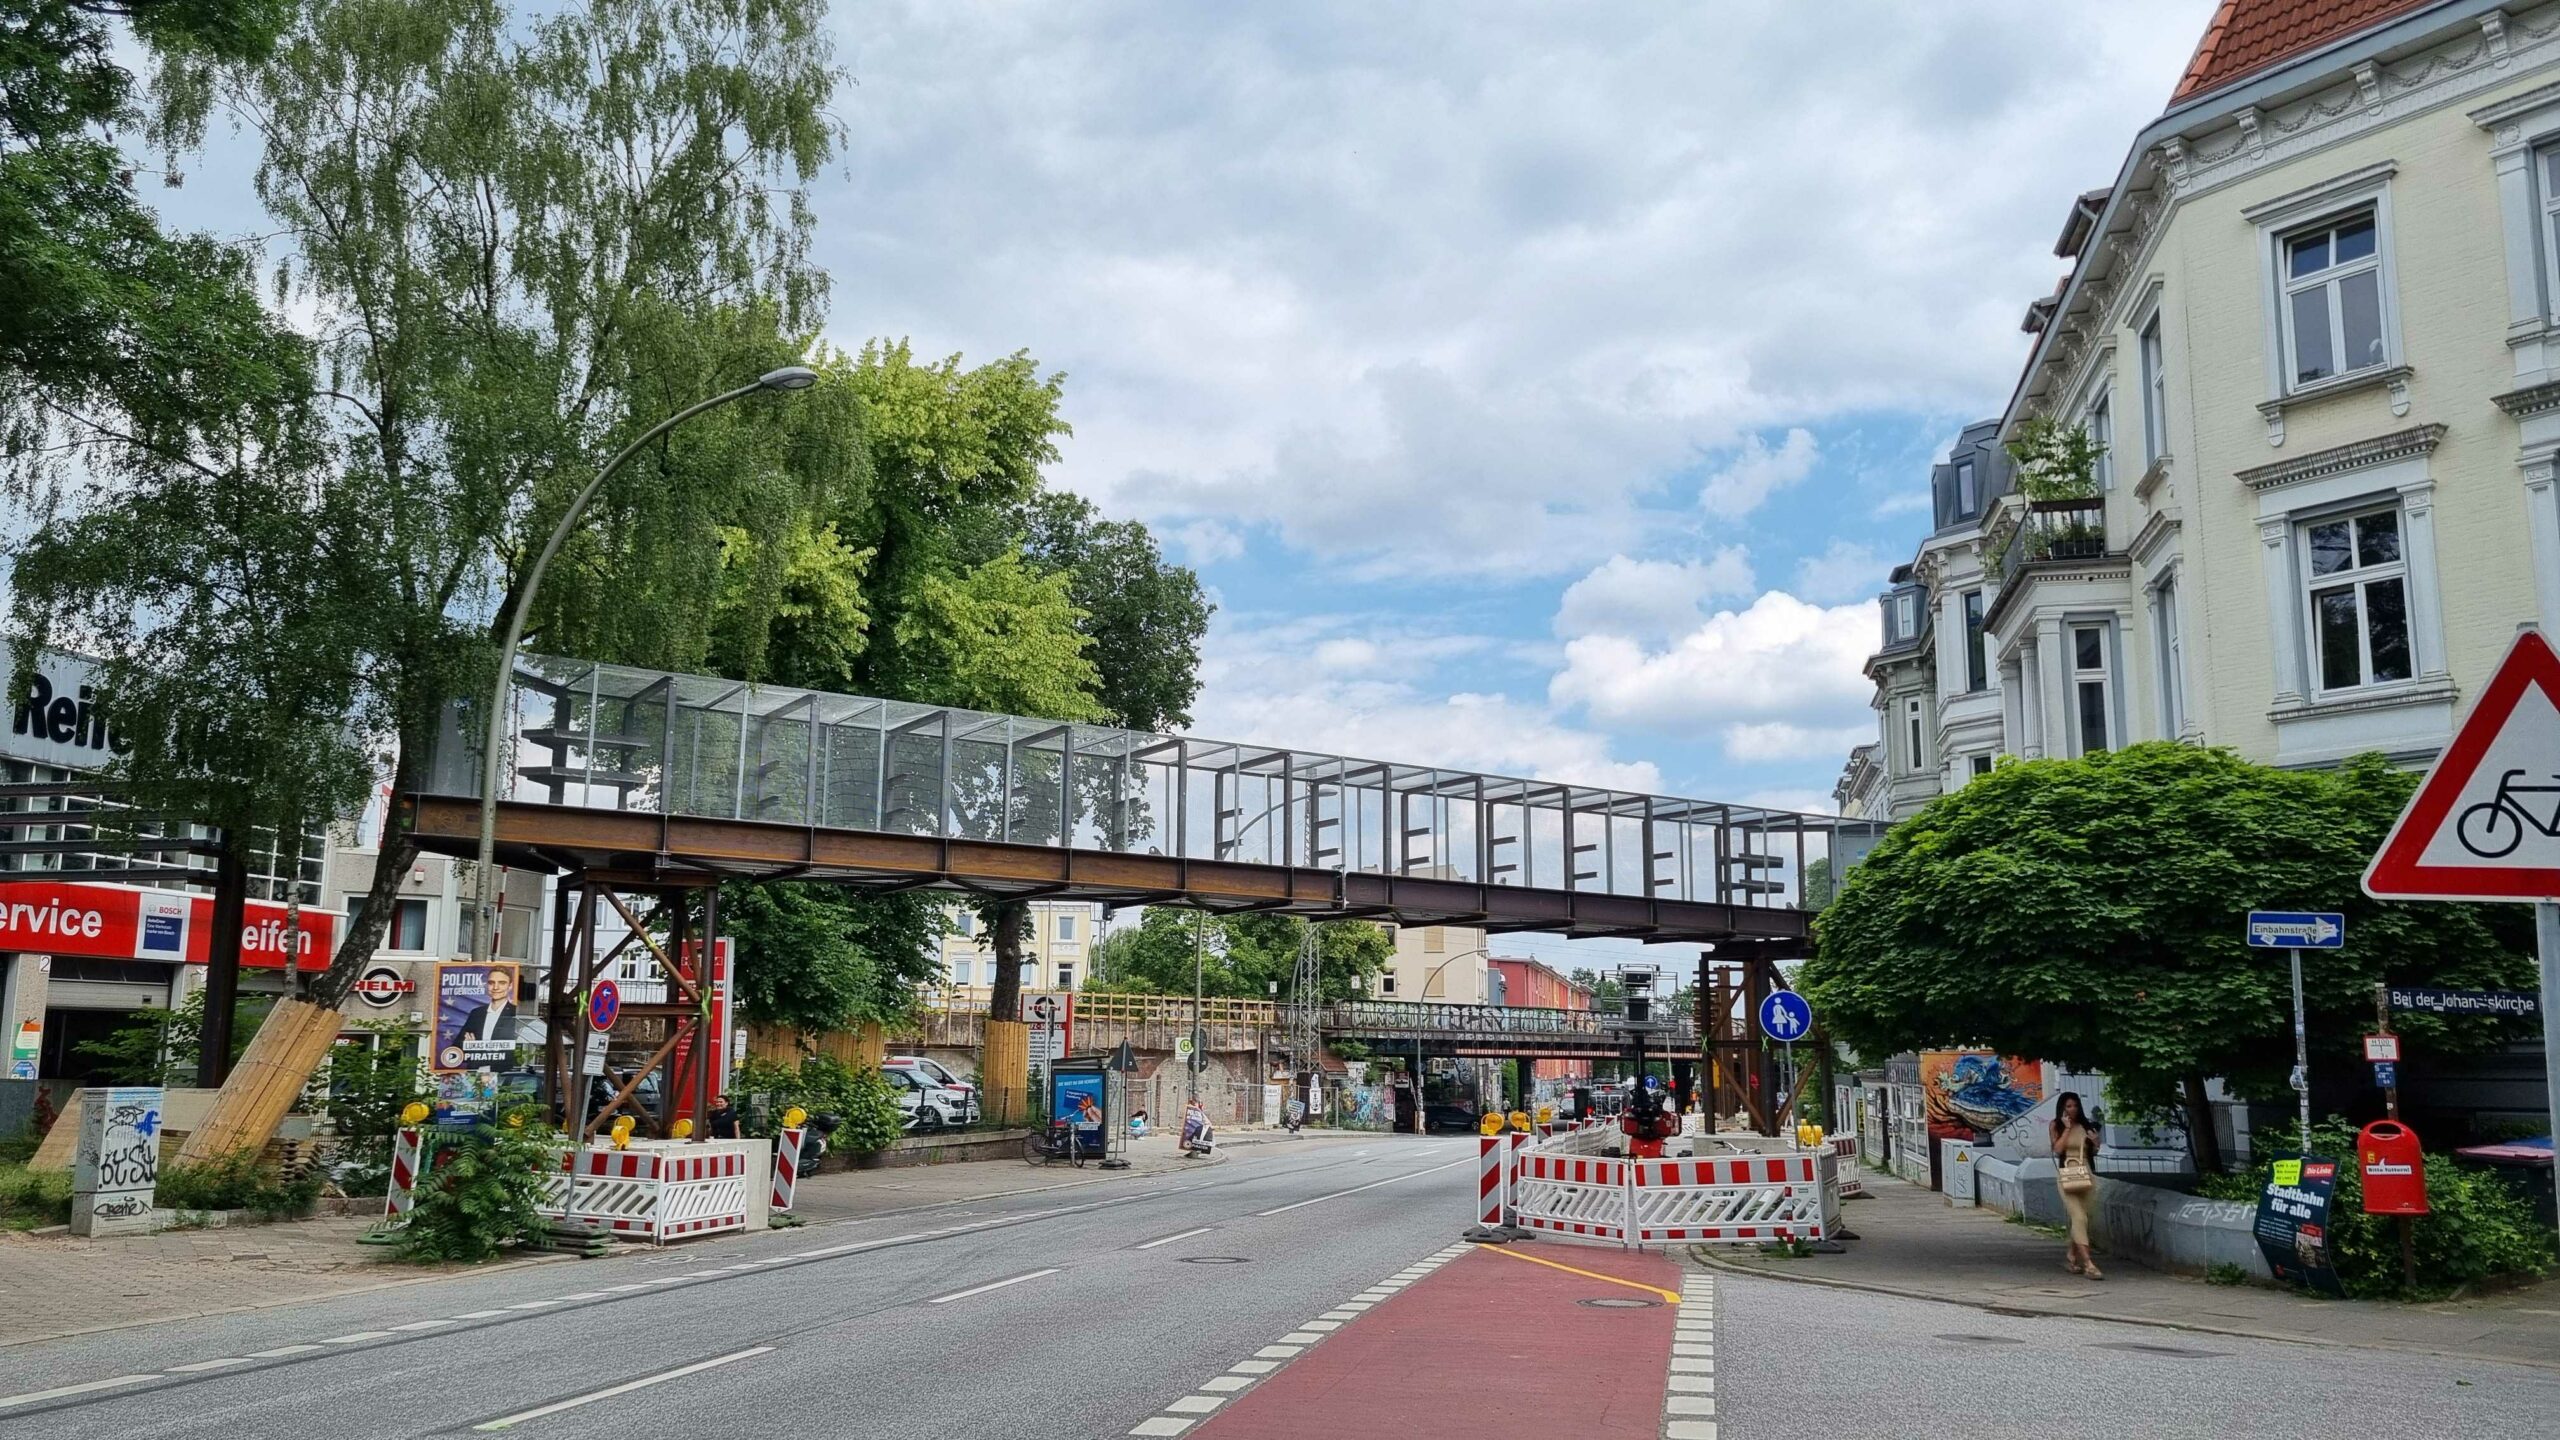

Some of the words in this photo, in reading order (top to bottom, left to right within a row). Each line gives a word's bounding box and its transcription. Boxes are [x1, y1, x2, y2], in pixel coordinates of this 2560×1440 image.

[159, 906, 182, 915] BOSCH
[2254, 924, 2317, 935] Einbahnstraße
[241, 919, 312, 954] eifen
[40, 956, 50, 972] 2
[352, 980, 414, 991] HELM
[442, 973, 484, 986] POLITIK
[441, 987, 453, 995] MIT
[453, 987, 485, 995] GEWISSEN
[2392, 992, 2412, 1006] Bei
[2416, 992, 2434, 1006] der
[464, 1052, 506, 1061] PIRATEN
[2266, 1183, 2325, 1208] Stadtbahn
[2271, 1198, 2289, 1214] für
[2289, 1204, 2311, 1219] alle
